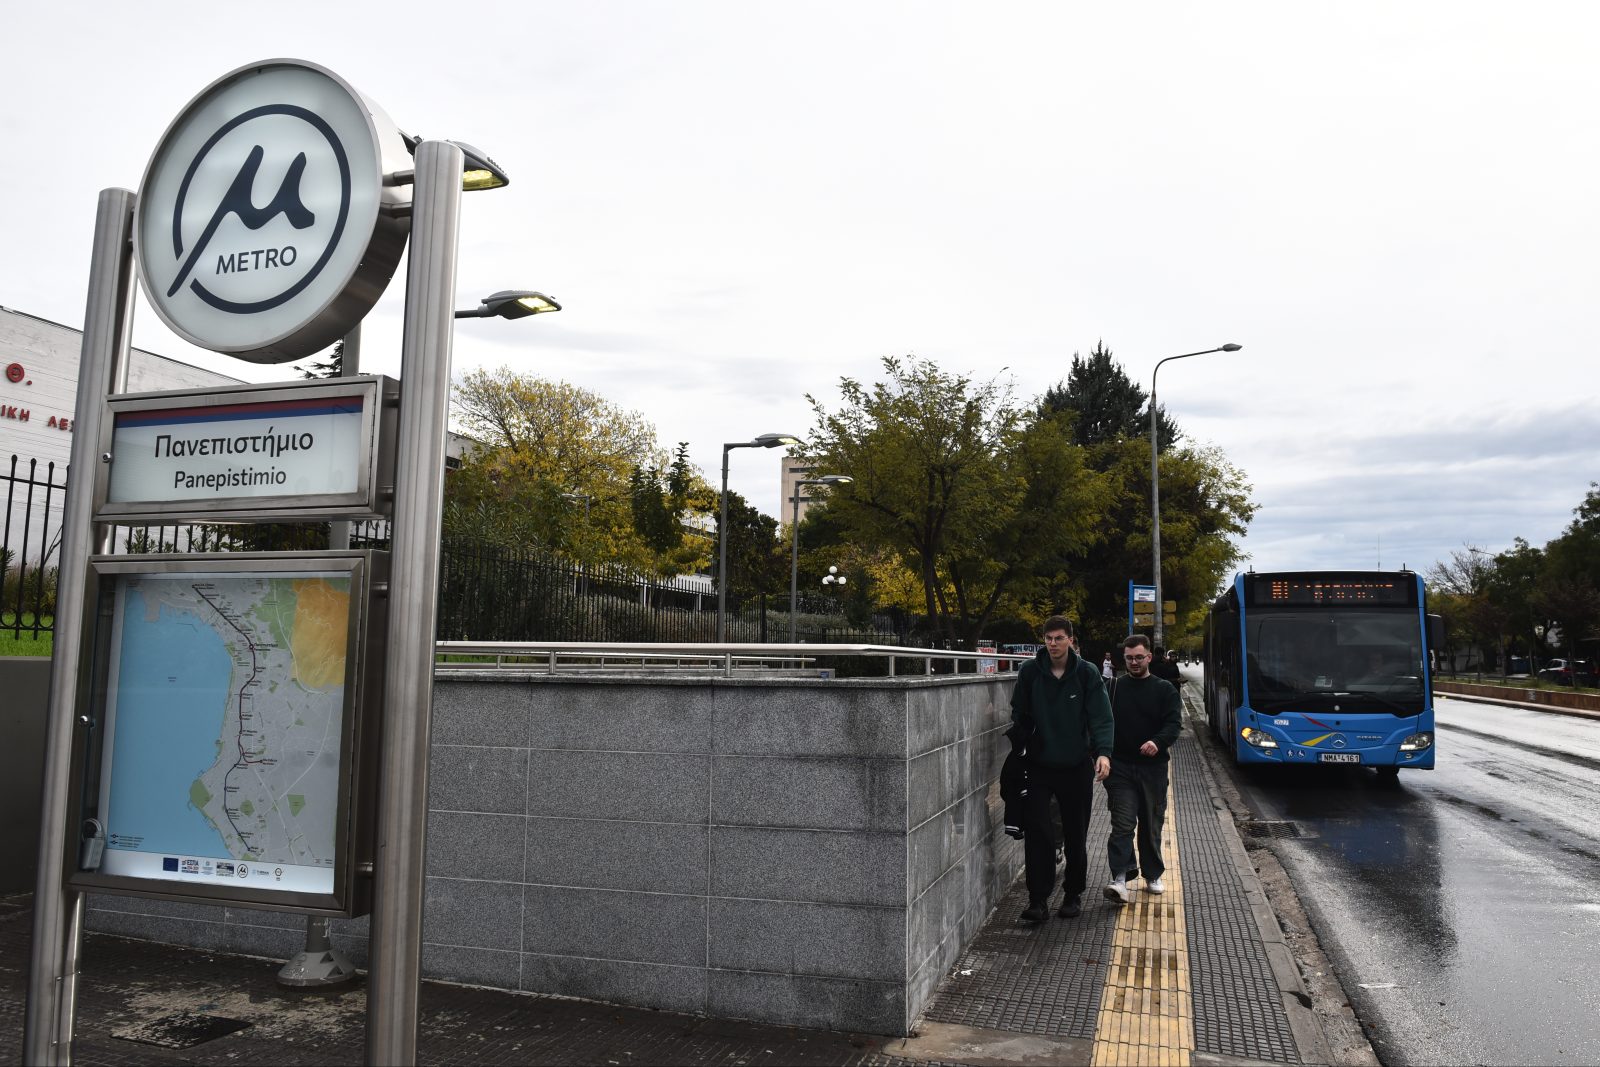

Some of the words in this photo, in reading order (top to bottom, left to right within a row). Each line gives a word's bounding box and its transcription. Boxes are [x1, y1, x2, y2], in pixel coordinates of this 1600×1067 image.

[215, 245, 297, 275] METRO
[154, 426, 314, 458] Πανεπιστήμιο
[174, 465, 287, 491] Panepistimio
